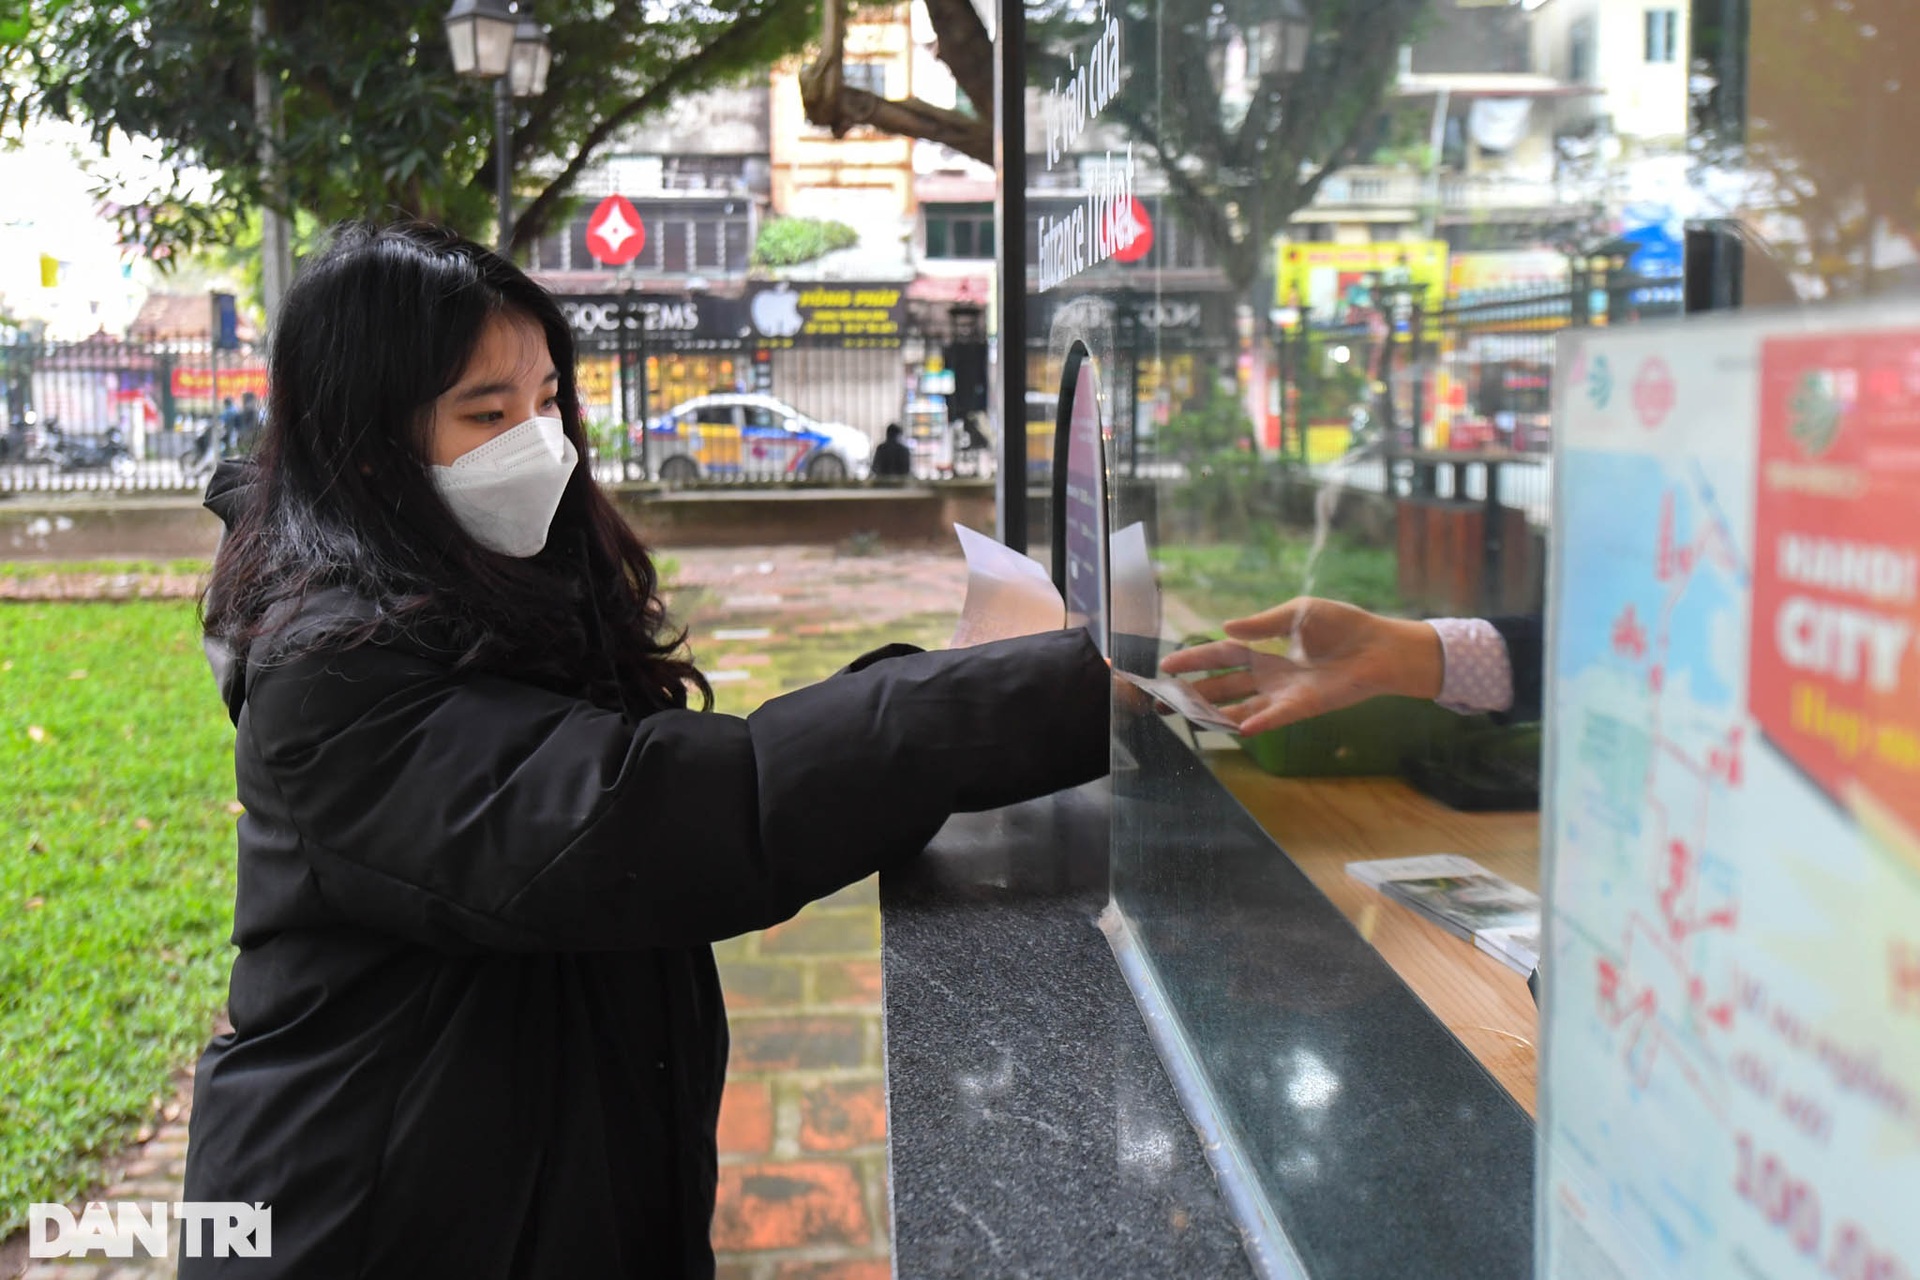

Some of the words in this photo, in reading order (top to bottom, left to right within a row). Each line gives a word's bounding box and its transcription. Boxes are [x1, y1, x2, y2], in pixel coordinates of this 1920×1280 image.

[1038, 203, 1084, 293] Entrance
[1088, 140, 1135, 267] Ticket
[1775, 596, 1911, 694] CITY
